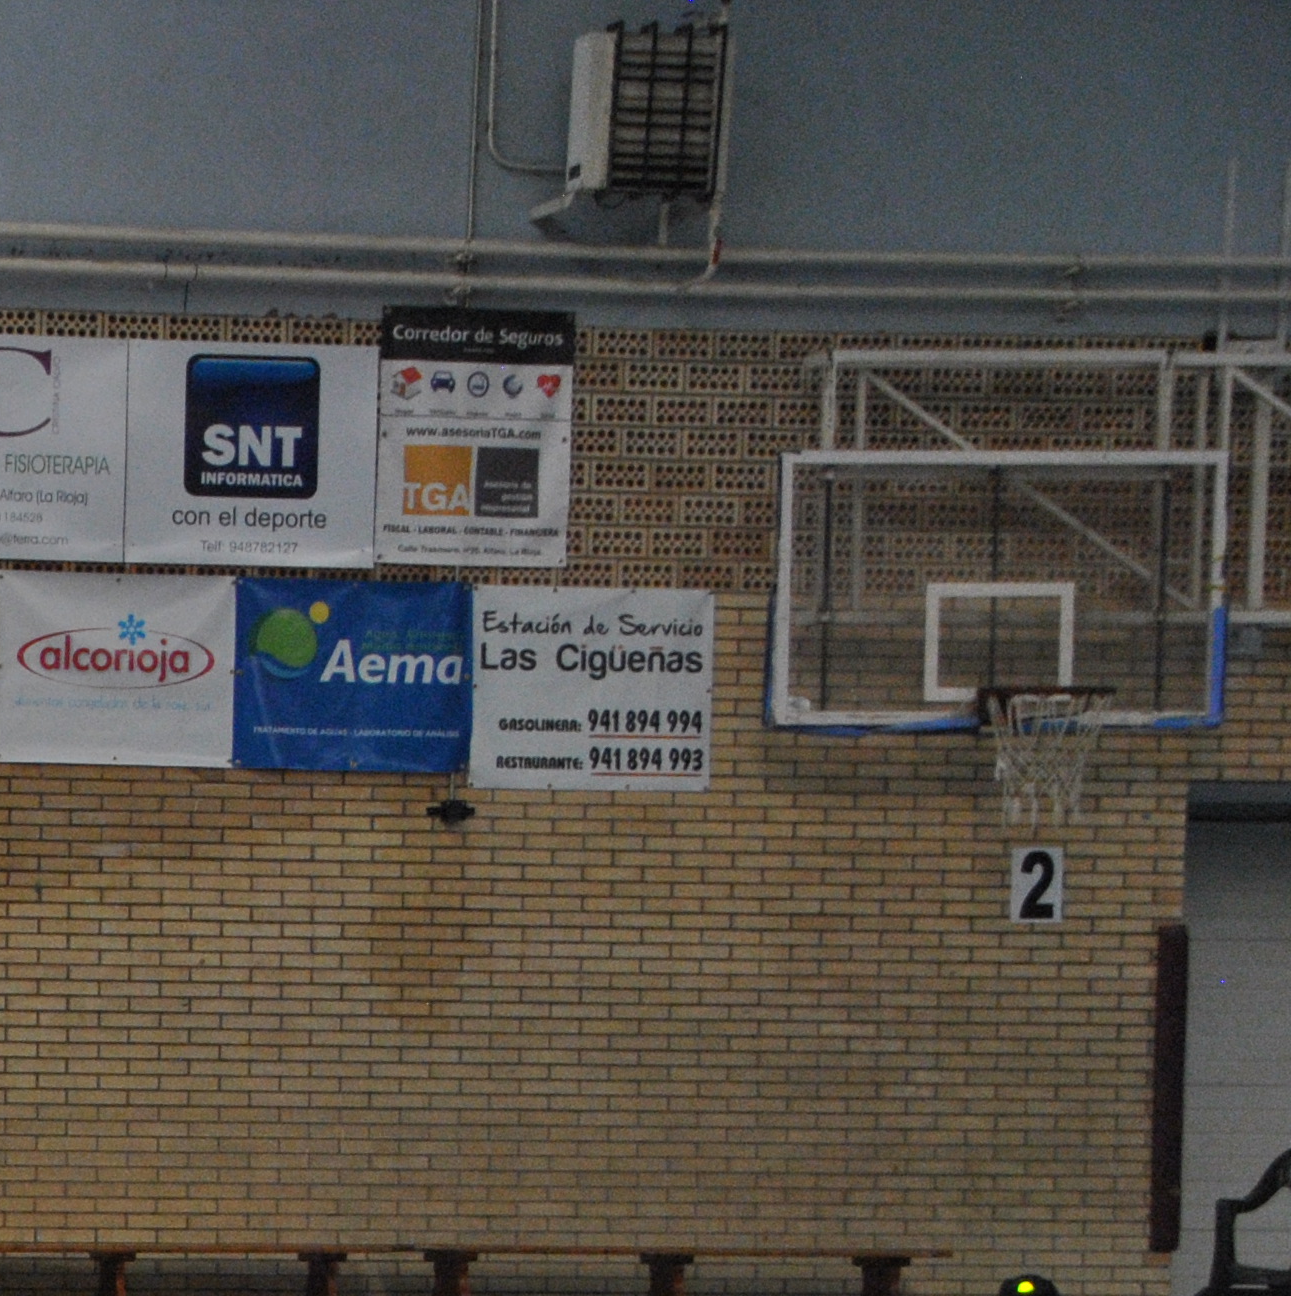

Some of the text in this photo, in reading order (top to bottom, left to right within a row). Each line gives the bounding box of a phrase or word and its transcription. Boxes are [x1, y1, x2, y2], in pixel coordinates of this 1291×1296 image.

[392, 324, 564, 349] Corredor de Seguros
[201, 424, 303, 468] SNT
[4, 454, 111, 476] FISIOTERAPIA
[200, 471, 303, 488] INFORMATICA
[0, 489, 33, 503] Alfaro
[404, 481, 470, 512] TGA
[172, 507, 327, 532] con el deporte
[482, 610, 703, 637] Estación de Servicio
[40, 634, 190, 682] alcorioja
[320, 639, 463, 684] Aema
[480, 642, 704, 680] Las Cigüeñas
[498, 709, 703, 734] GASOLINERA: 941 894 994
[496, 746, 704, 772] RESTAURANTE: 941 894 993
[1019, 850, 1055, 920] 2
